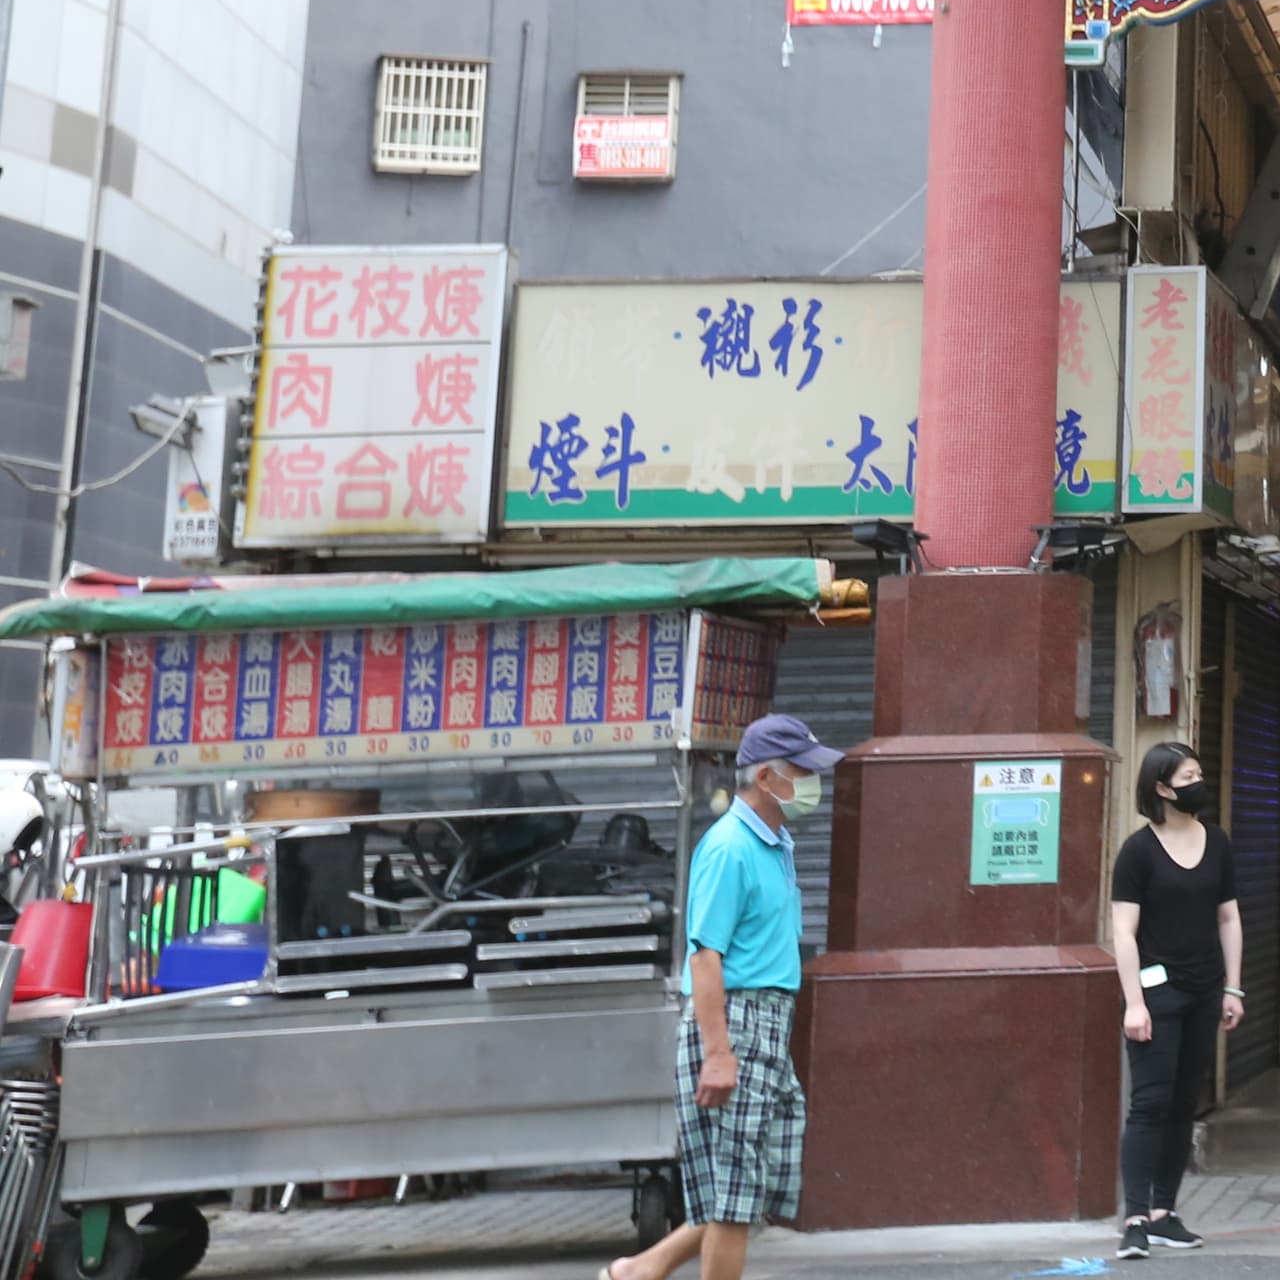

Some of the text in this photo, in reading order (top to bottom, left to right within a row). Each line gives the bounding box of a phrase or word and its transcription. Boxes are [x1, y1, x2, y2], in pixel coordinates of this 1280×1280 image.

[277, 264, 486, 339] 花枝焿
[696, 298, 824, 392] 襯衫
[1135, 278, 1193, 498] 老花眼鏡
[259, 442, 471, 520] 綜合焿
[528, 412, 647, 509] 煙斗
[325, 740, 347, 757] 30
[408, 736, 430, 752] 30
[612, 726, 633, 742] 30
[1000, 767, 1035, 784] 注意
[992, 844, 1038, 856] 請戴口罩
